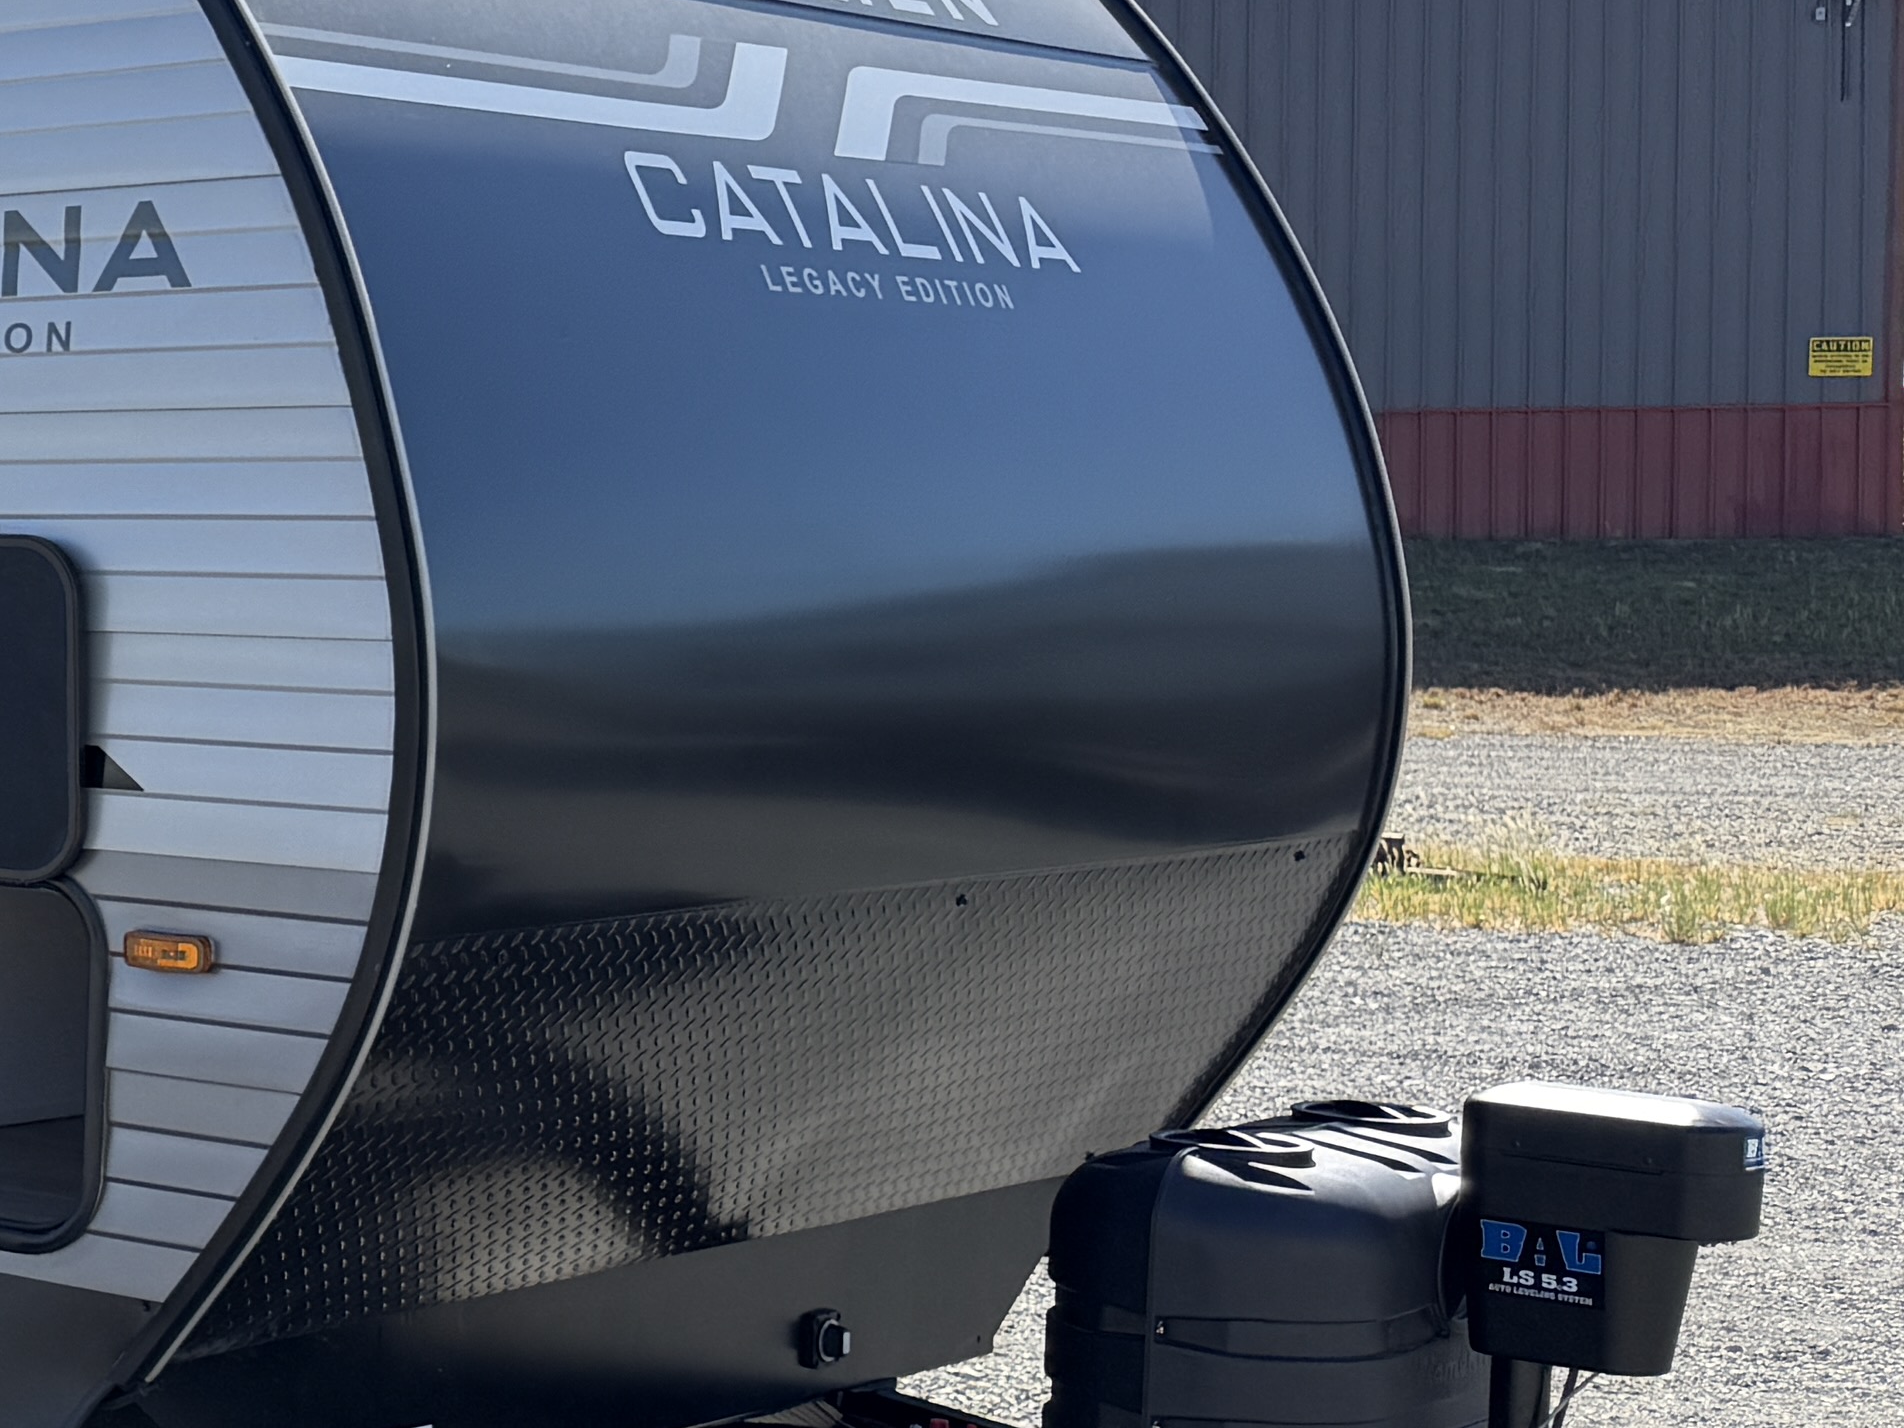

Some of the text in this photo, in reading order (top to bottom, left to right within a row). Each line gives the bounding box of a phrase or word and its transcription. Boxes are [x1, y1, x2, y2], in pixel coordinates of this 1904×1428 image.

[624, 151, 1081, 272] CATALINA
[760, 264, 1014, 309] LEGACY EDITION
[1813, 341, 1870, 351] CAUTION
[1480, 1218, 1601, 1275] BAL
[1489, 1283, 1512, 1293] AUTO
[1503, 1267, 1578, 1292] LS 5.3
